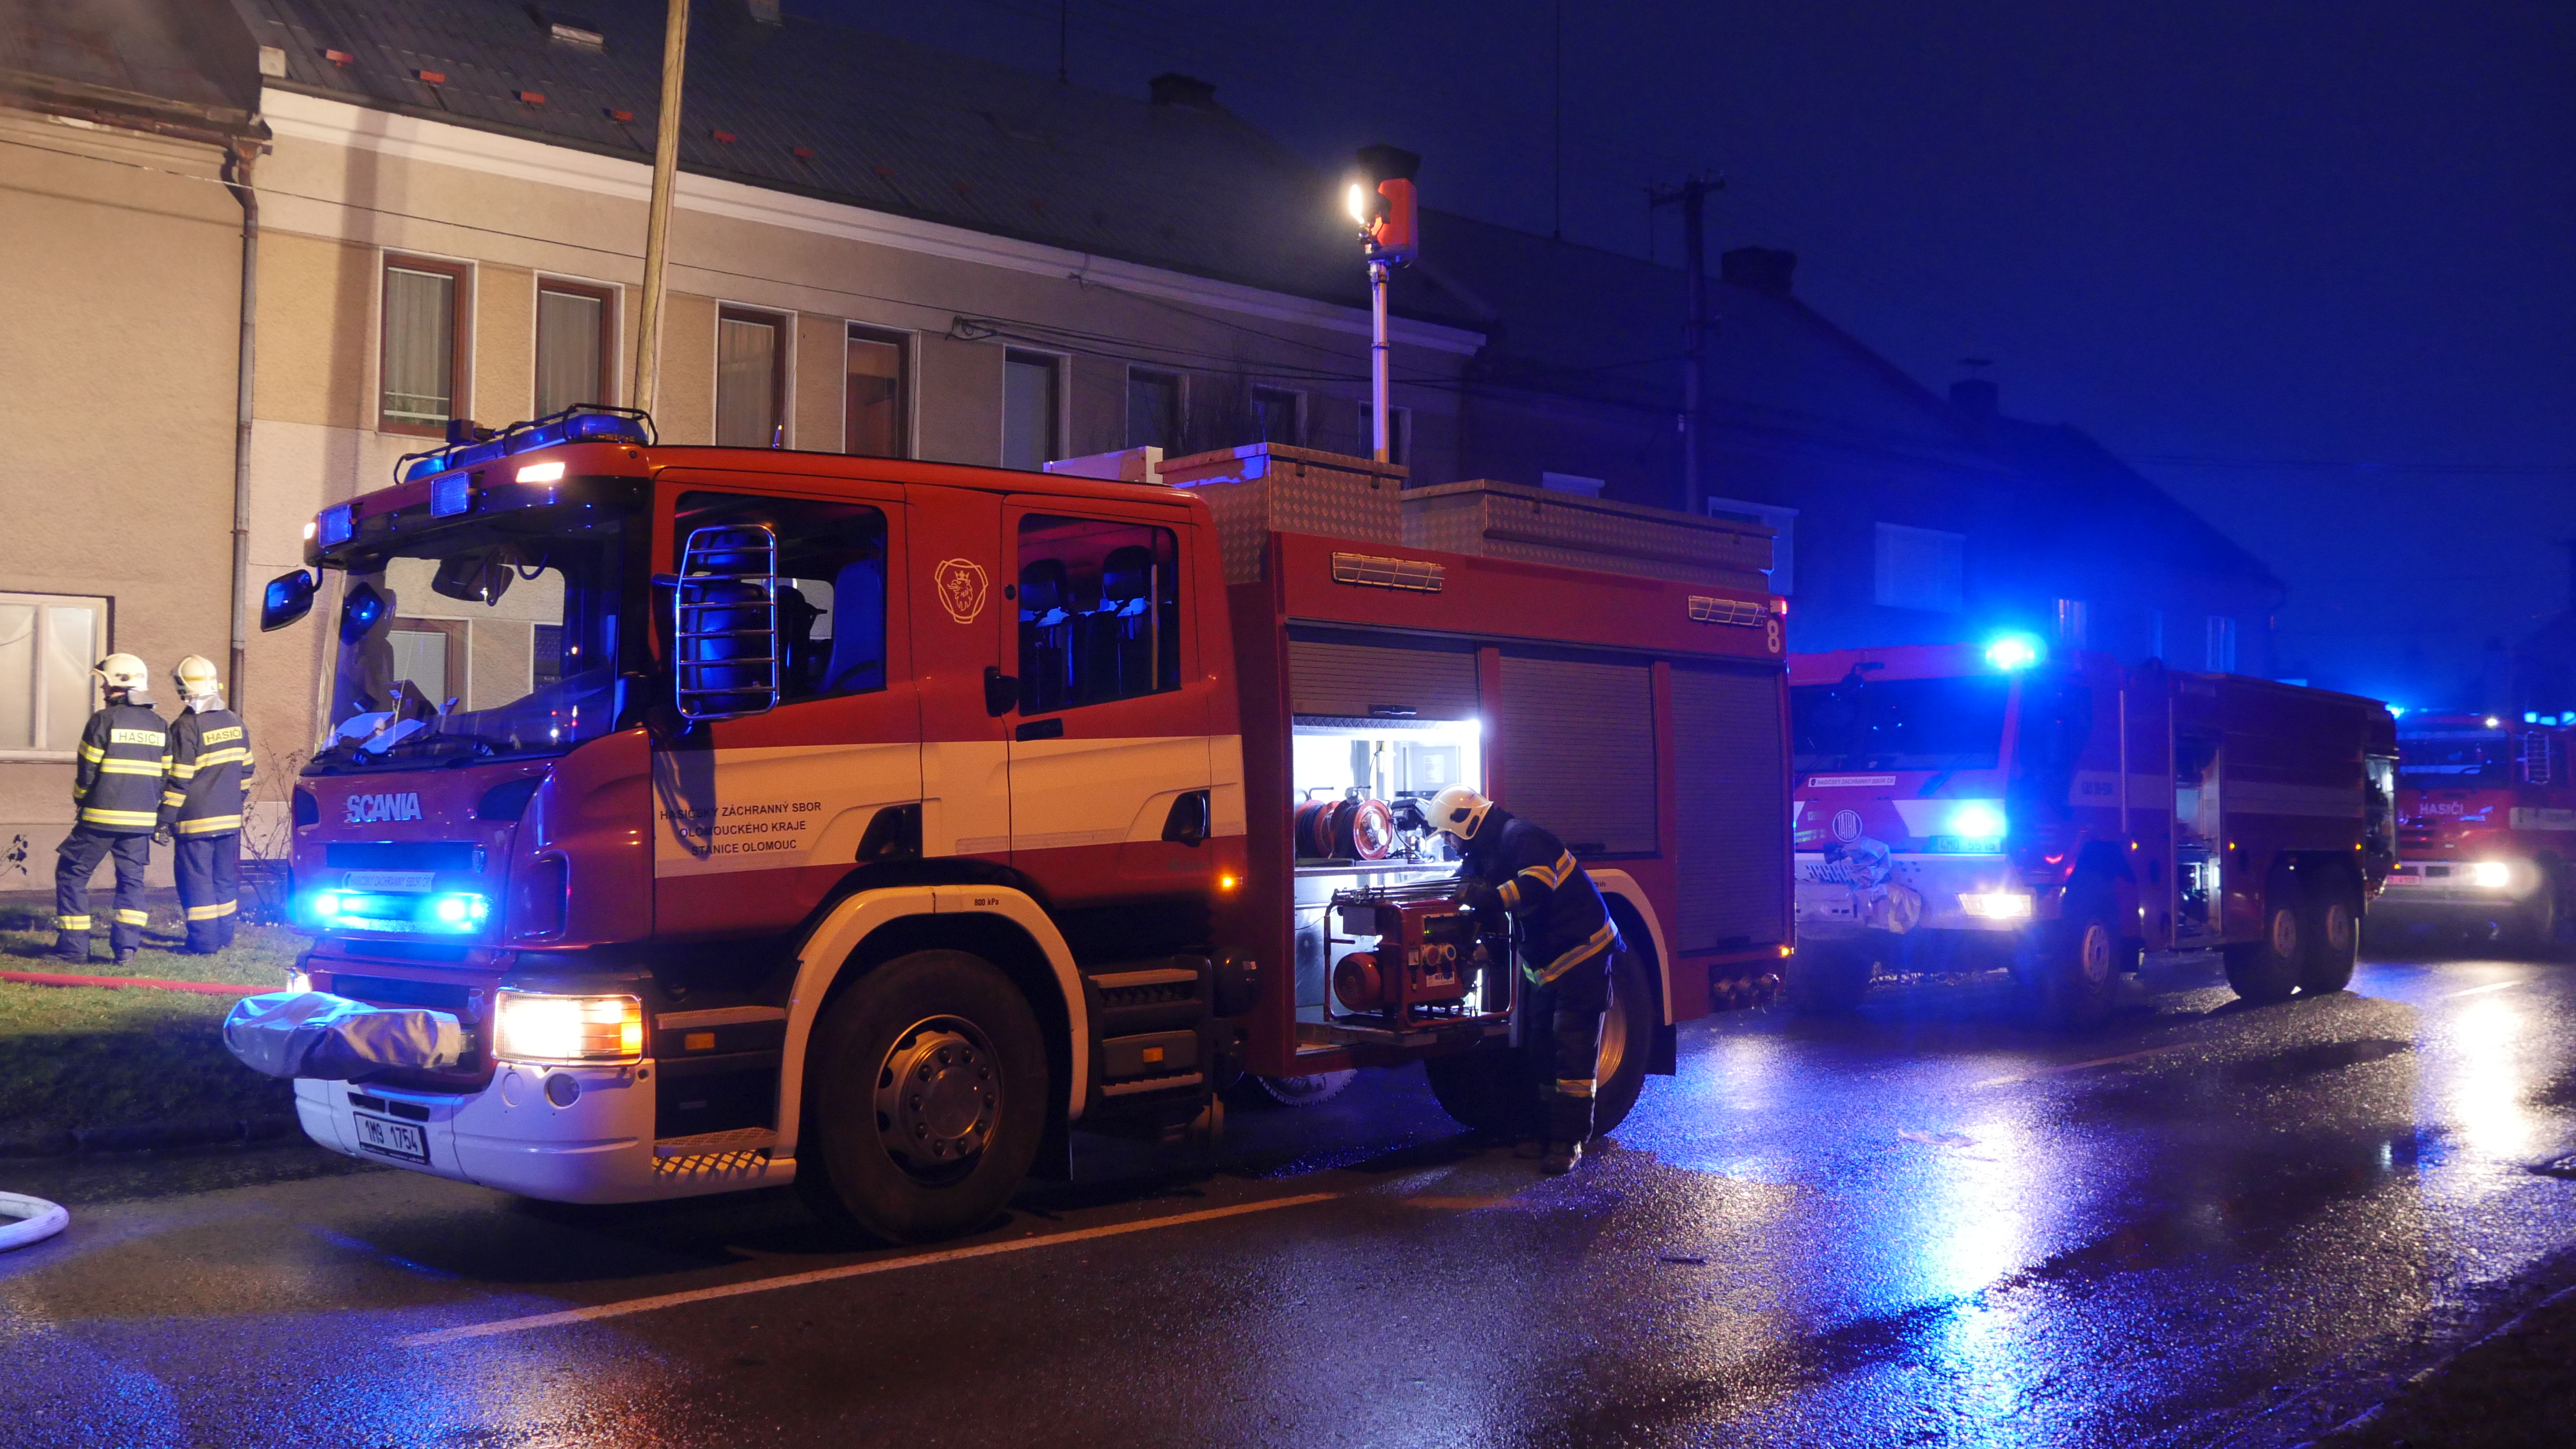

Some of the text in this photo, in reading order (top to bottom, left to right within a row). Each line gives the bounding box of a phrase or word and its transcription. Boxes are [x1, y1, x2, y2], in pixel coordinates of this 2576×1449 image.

[1767, 619, 1780, 653] 8
[119, 731, 159, 745] HASIČI
[206, 728, 242, 744] HASIČI
[347, 792, 422, 822] SCANIA
[722, 801, 789, 817] ZÁCHRANNÝ
[792, 802, 822, 813] SBOR
[679, 821, 806, 837] OLOMOUCKÉHO KRAJE
[1837, 812, 1857, 840] TATRA
[691, 840, 797, 855] STANICE OLOMOUC
[391, 1126, 418, 1152] 1754
